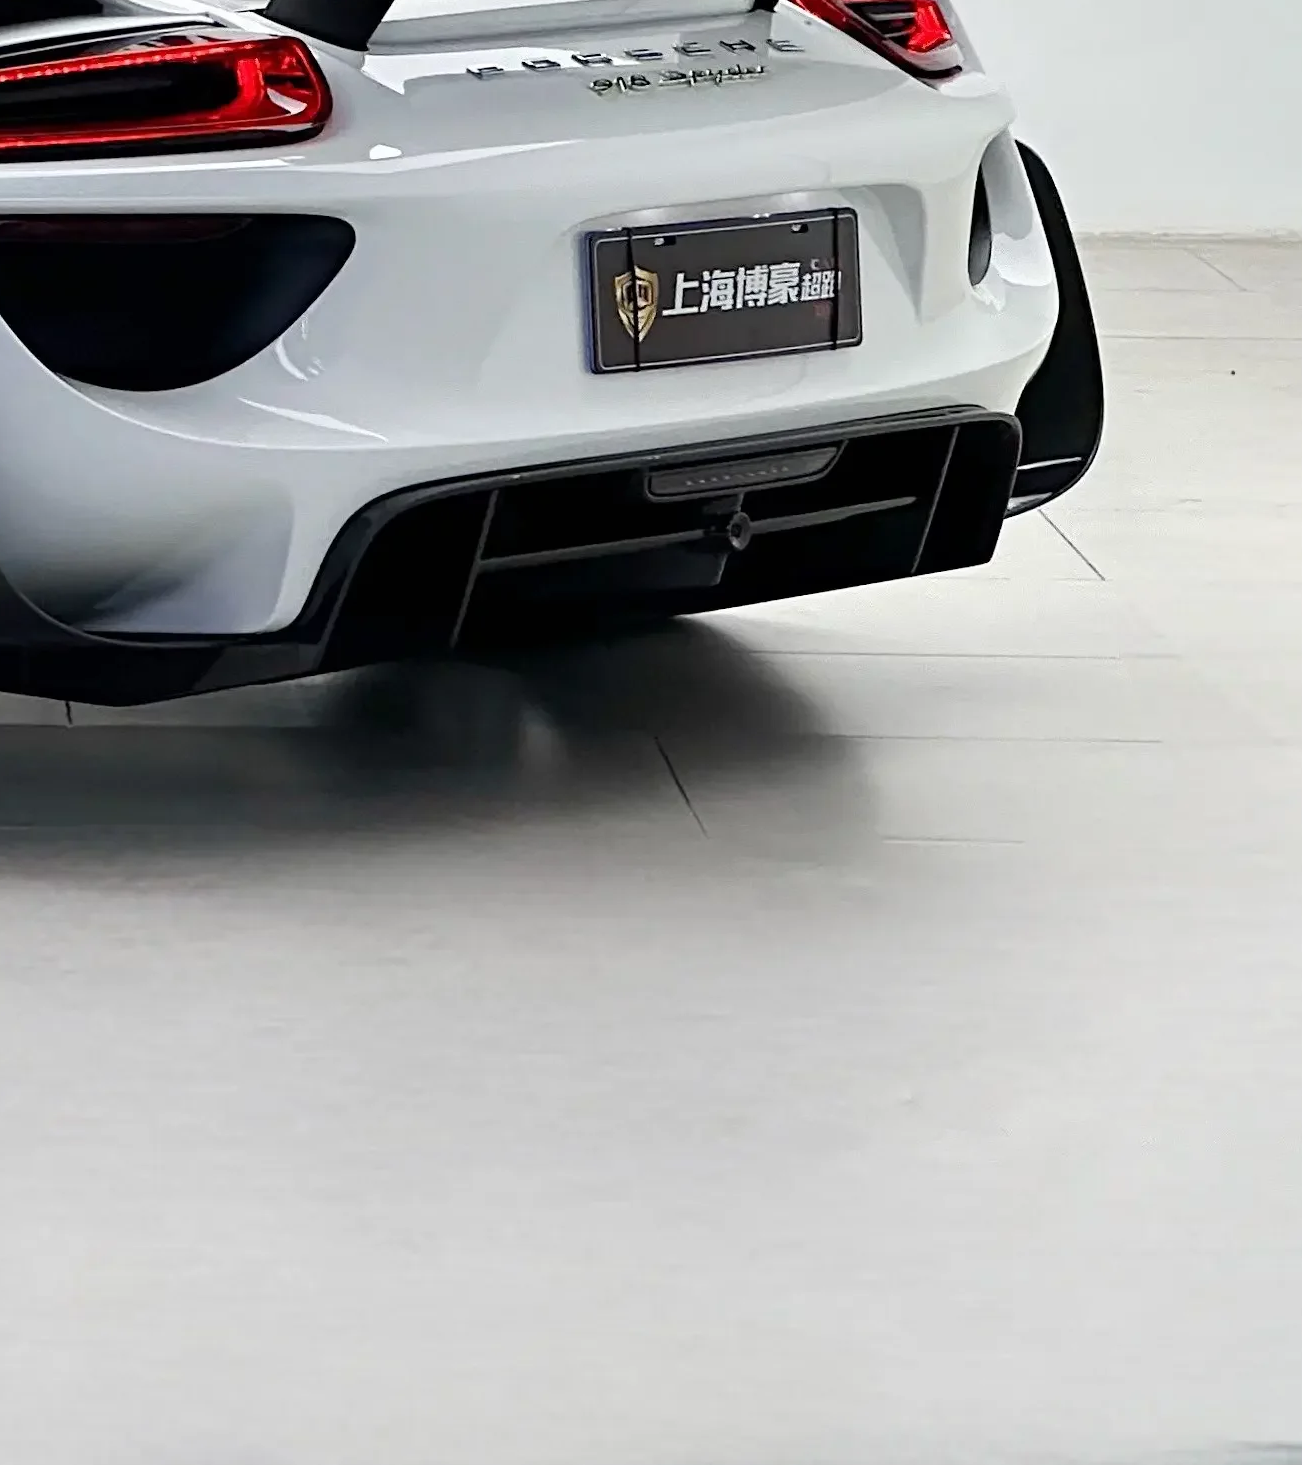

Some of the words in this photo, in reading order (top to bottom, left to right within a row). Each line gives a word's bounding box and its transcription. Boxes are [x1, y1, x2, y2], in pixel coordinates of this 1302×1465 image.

[466, 38, 804, 79] PORSCHE
[662, 261, 800, 317] 上海博豪
